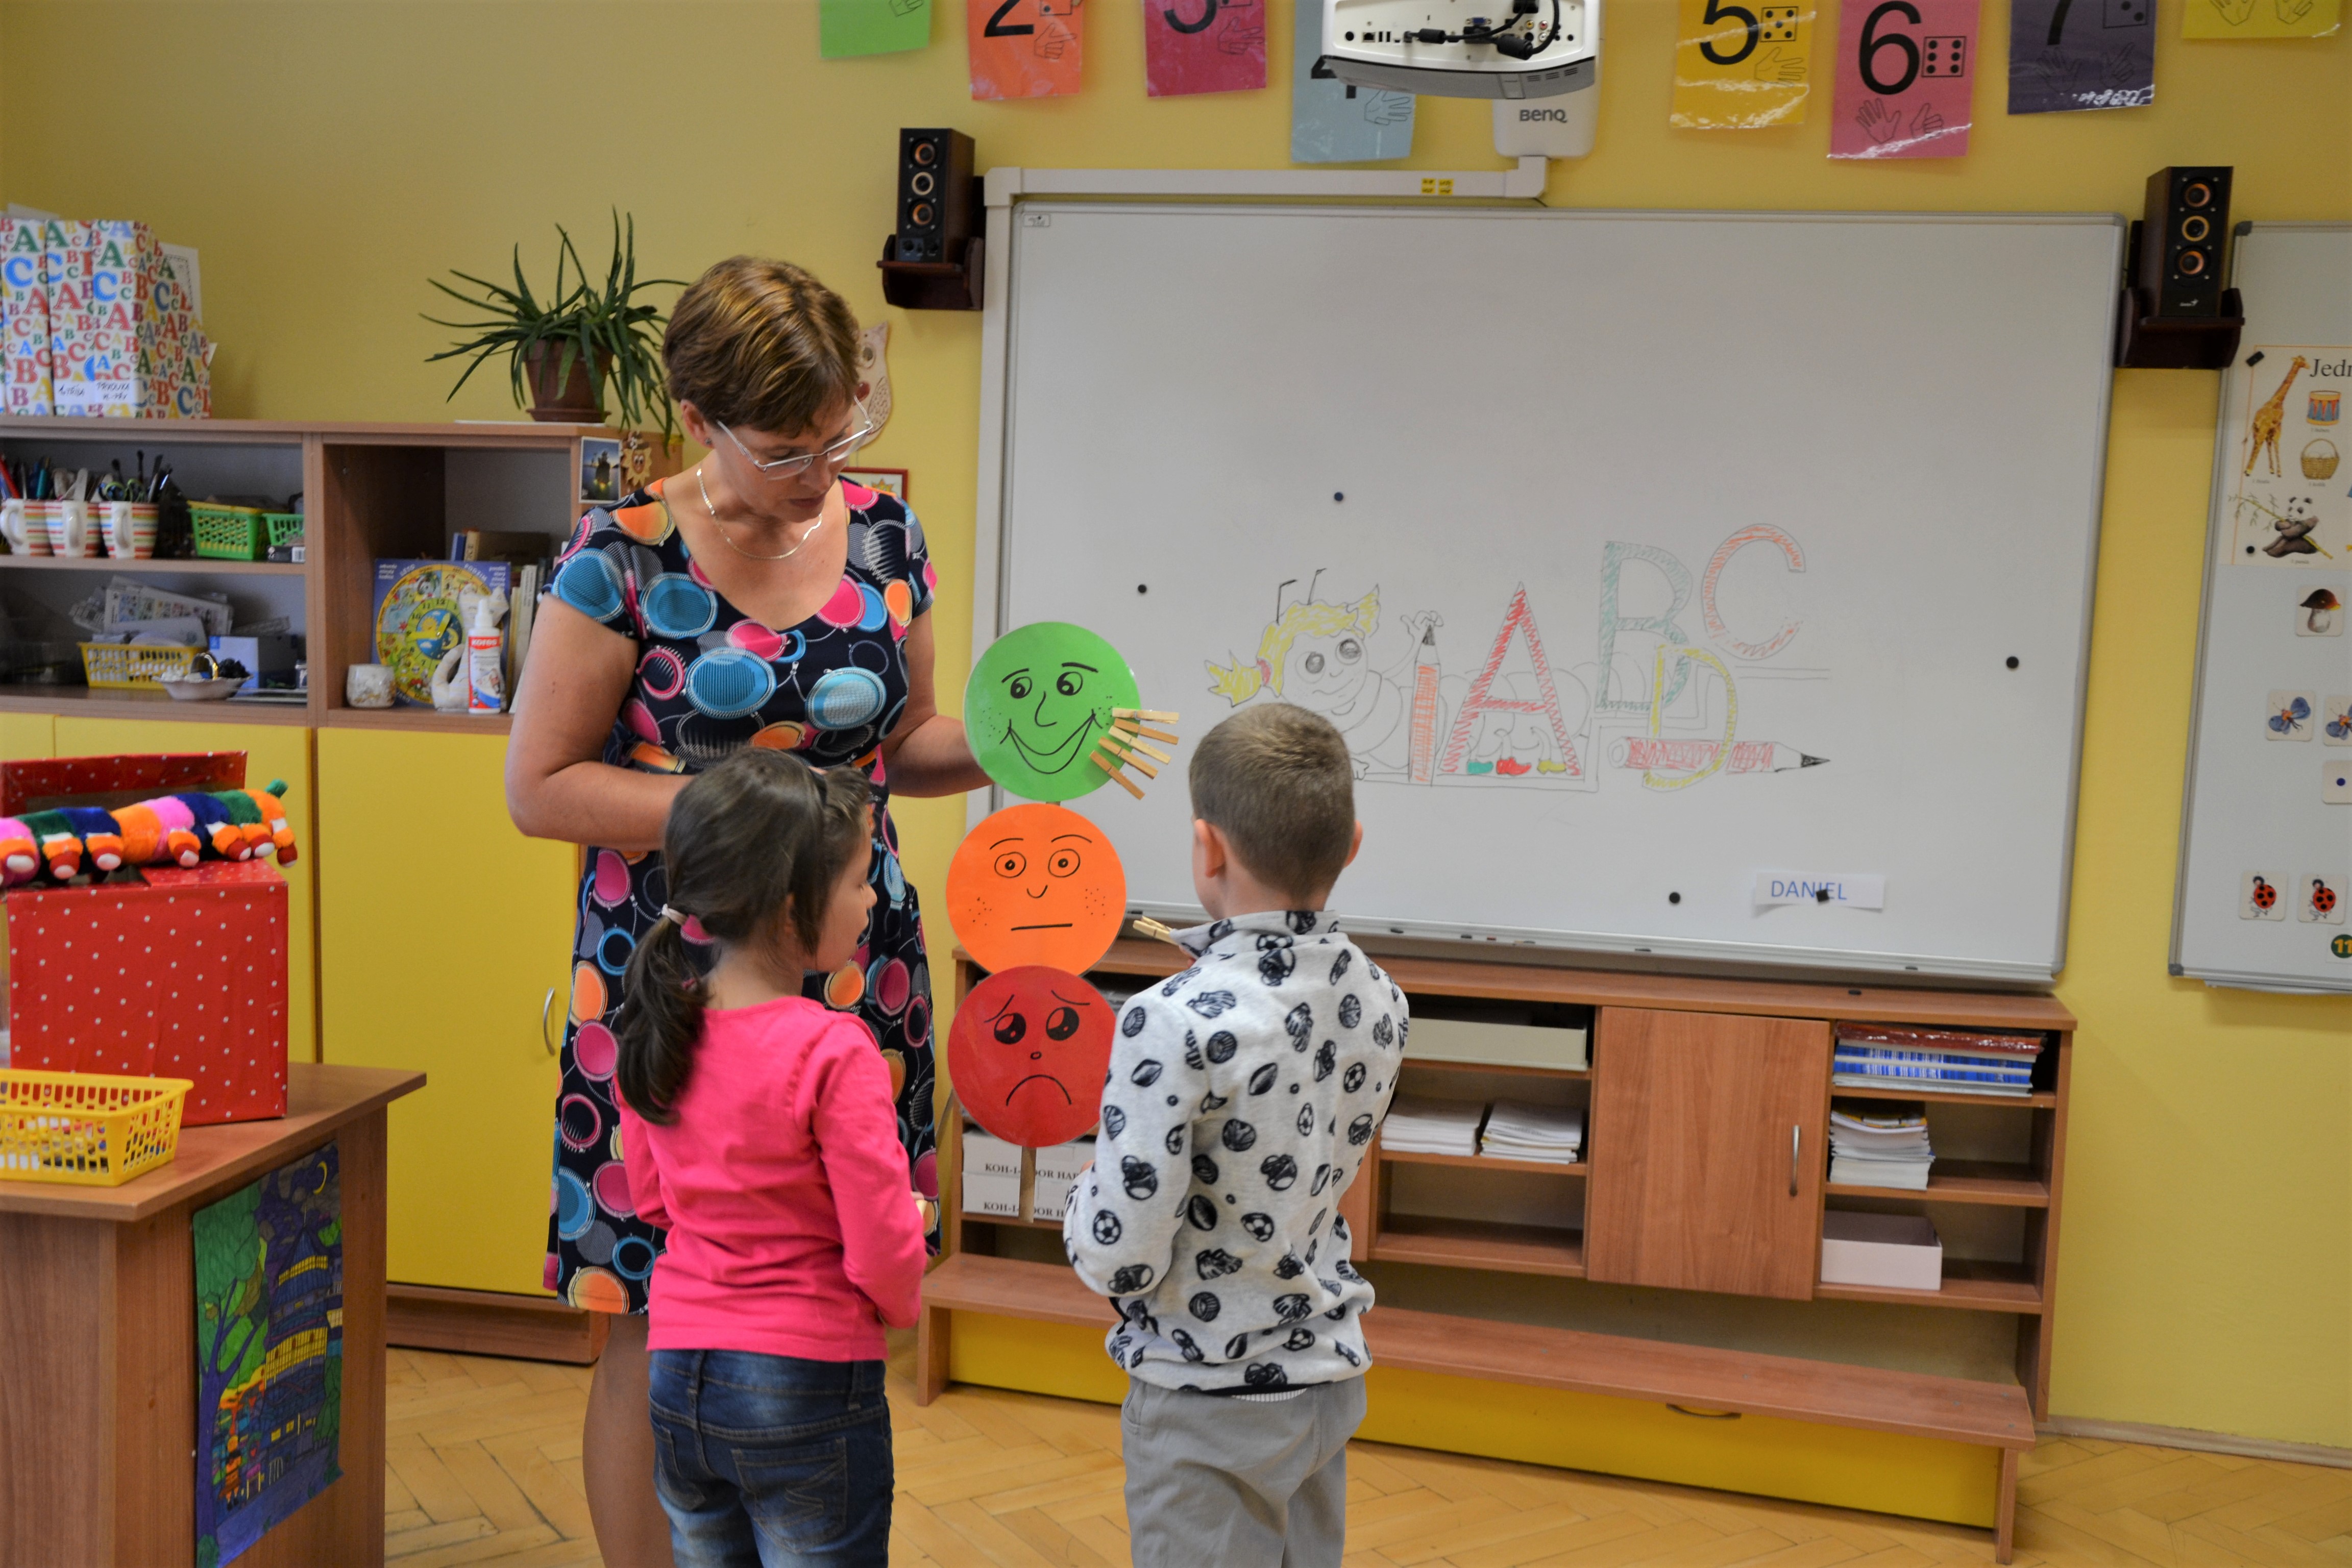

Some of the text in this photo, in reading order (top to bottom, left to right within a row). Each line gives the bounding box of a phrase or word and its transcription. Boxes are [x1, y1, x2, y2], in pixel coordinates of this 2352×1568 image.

[1700, 0, 1758, 65] 5
[1859, 1, 1921, 95] 6
[1520, 109, 1567, 122] BenQ
[0, 218, 14, 231] B
[109, 221, 133, 237] A
[10, 224, 41, 252] A
[136, 233, 146, 252] C
[97, 240, 126, 267] A
[5, 257, 33, 287] C
[148, 264, 158, 284] C
[158, 257, 176, 279] A
[53, 283, 84, 309] A
[93, 271, 118, 302] C
[134, 273, 149, 300] B
[154, 282, 170, 311] C
[23, 287, 50, 315] A
[144, 296, 159, 321] A
[76, 315, 92, 330] B
[104, 302, 133, 330] A
[132, 303, 143, 322] B
[179, 314, 188, 332] B
[13, 318, 31, 336] C
[142, 322, 156, 345] A
[162, 313, 178, 340] A
[18, 340, 33, 355] A
[52, 336, 66, 351] A
[68, 342, 86, 361] C
[94, 332, 110, 350] C
[124, 336, 140, 352] B
[156, 341, 166, 359] C
[188, 332, 202, 355] A
[36, 348, 52, 367] C
[52, 355, 71, 379] B
[96, 355, 111, 370] A
[135, 347, 152, 375] A
[14, 358, 37, 383] B
[113, 363, 131, 379] C
[182, 356, 197, 383] A
[31, 377, 53, 401] A
[169, 372, 179, 390] C
[12, 388, 29, 405] B
[157, 381, 170, 405] B
[177, 386, 193, 415] C
[168, 400, 179, 419] A
[1771, 880, 1847, 900] DANIEL
[2335, 939, 2352, 954] 11
